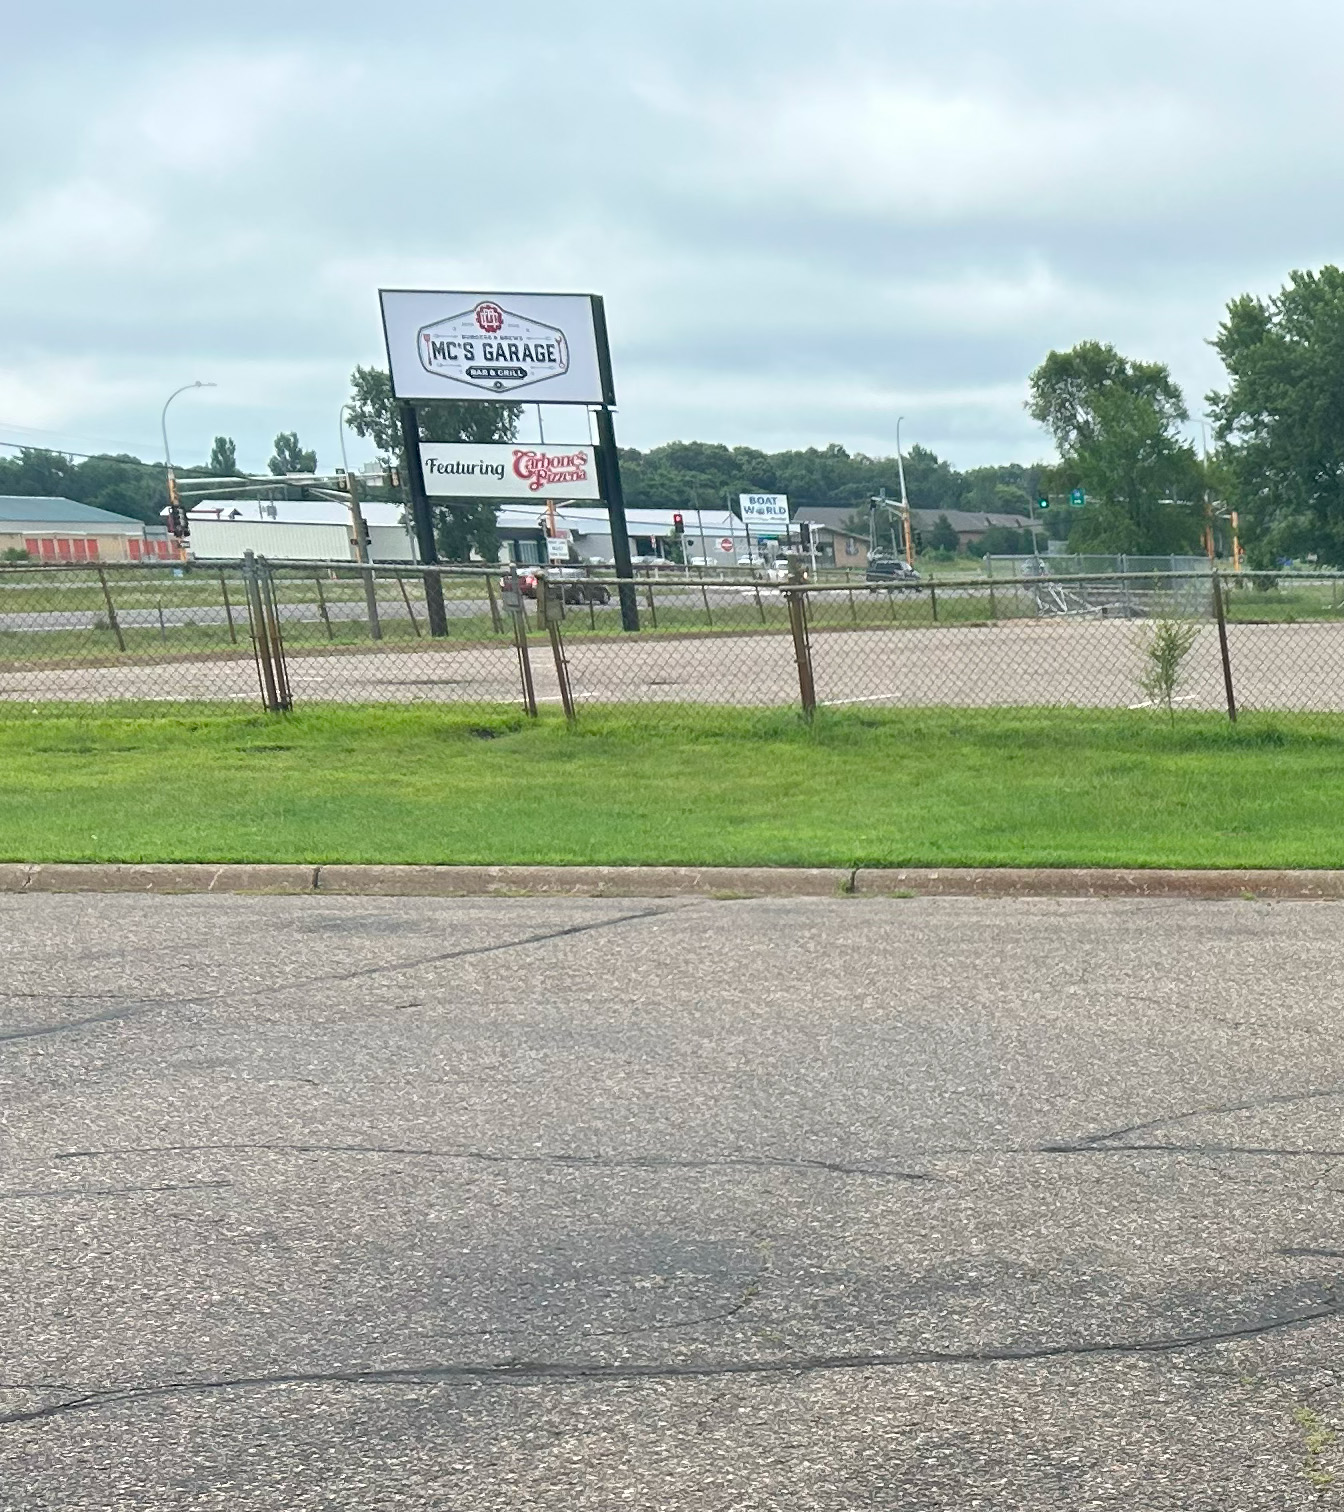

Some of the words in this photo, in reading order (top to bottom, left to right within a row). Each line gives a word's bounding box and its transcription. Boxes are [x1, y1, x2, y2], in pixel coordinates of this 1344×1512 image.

[431, 341, 475, 361] MC'S
[482, 342, 557, 363] GARAGE
[497, 369, 523, 377] GRILL
[425, 458, 505, 480] Featuring
[749, 496, 777, 505] BOAT
[743, 506, 786, 515] WORLD
